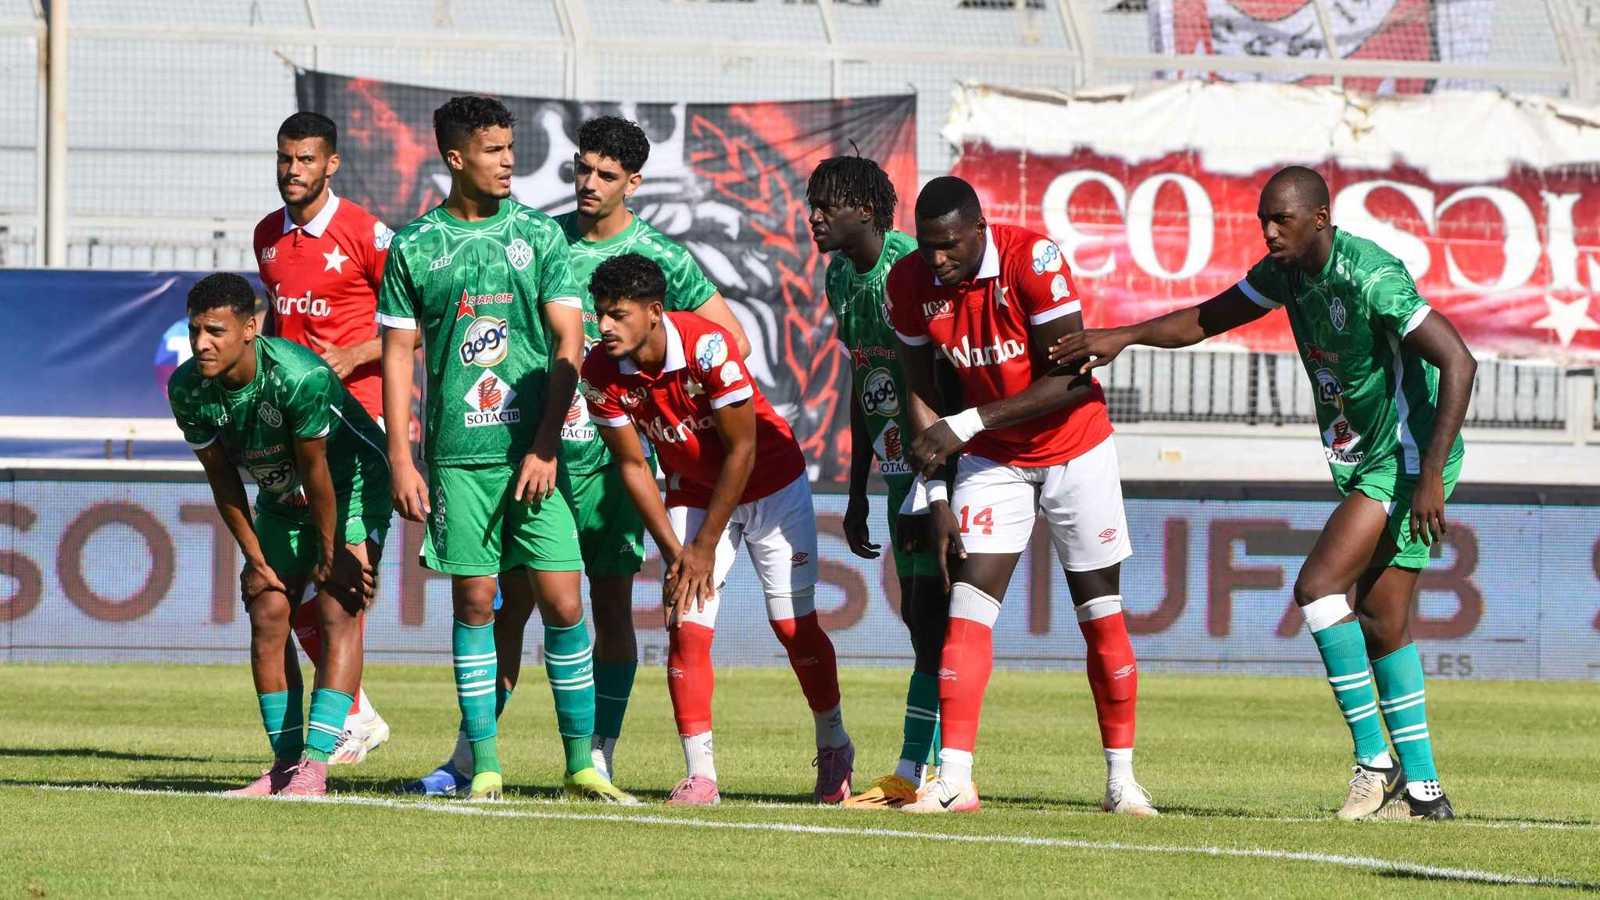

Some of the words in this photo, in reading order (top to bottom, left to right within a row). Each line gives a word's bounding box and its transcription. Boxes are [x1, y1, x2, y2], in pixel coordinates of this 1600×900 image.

[1332, 179, 1600, 294] ICS
[275, 282, 331, 317] arda
[467, 410, 520, 425] SOTACIB
[561, 427, 595, 440] TACIB
[959, 504, 994, 535] 14
